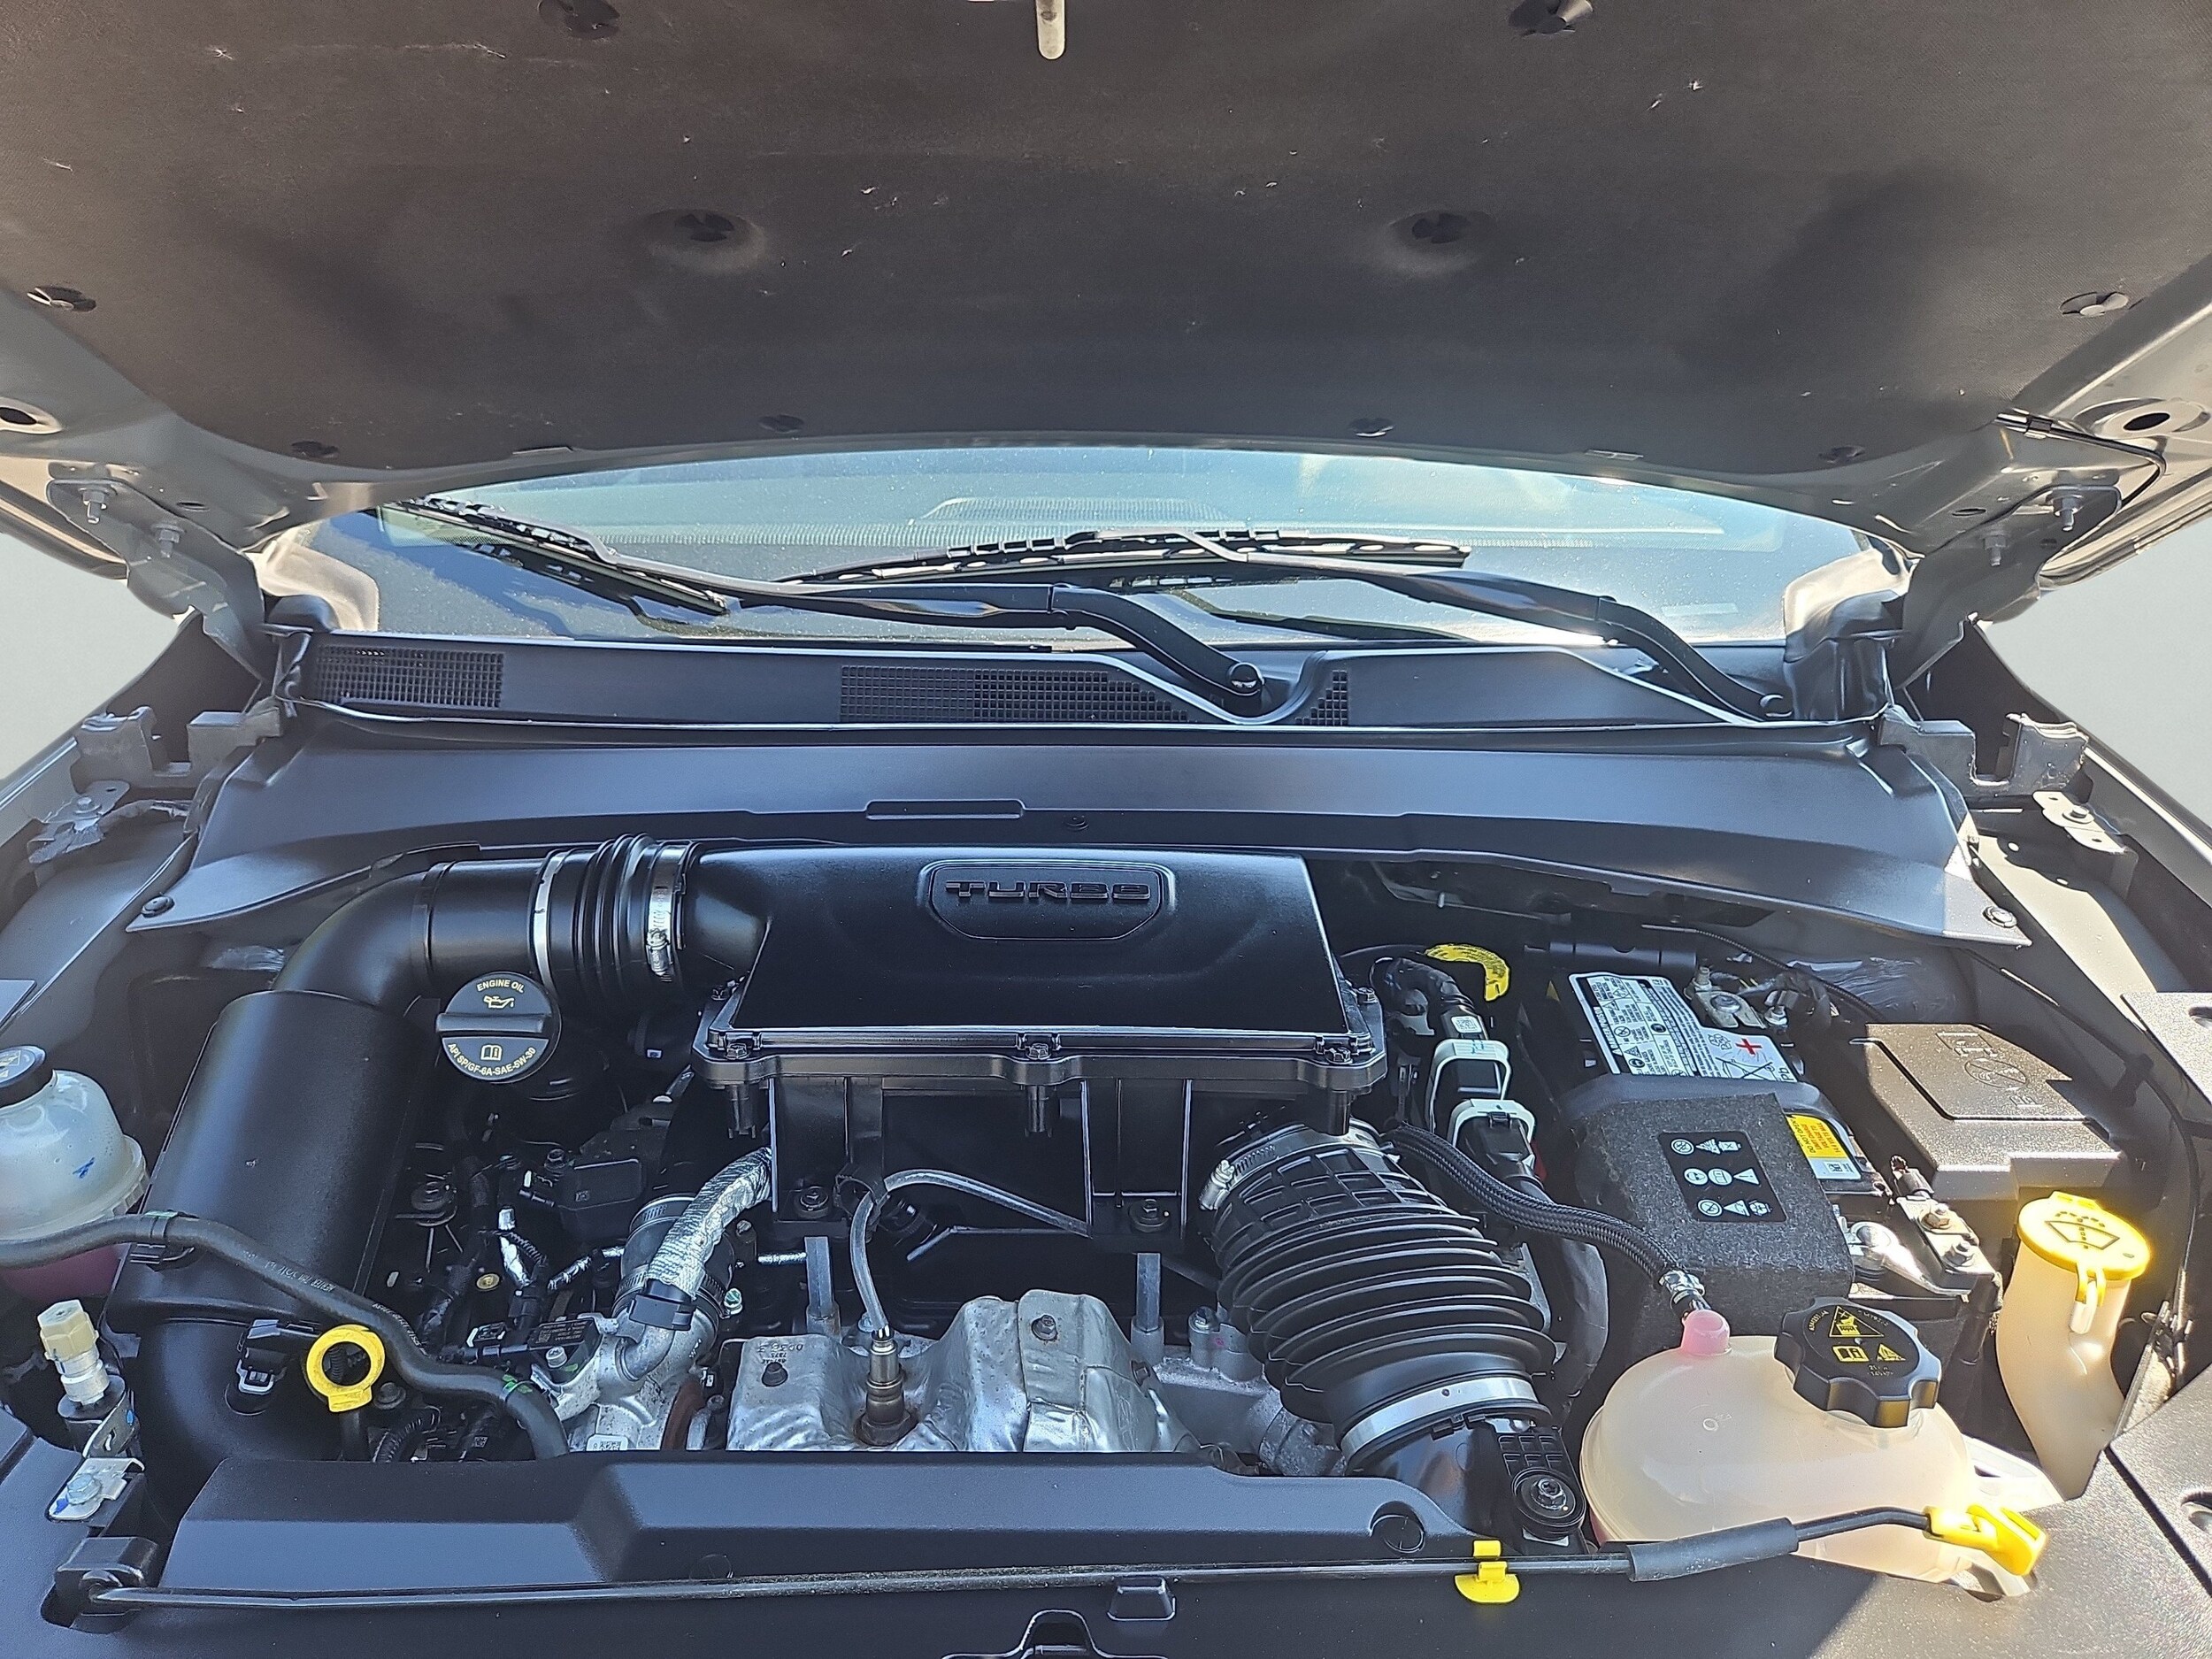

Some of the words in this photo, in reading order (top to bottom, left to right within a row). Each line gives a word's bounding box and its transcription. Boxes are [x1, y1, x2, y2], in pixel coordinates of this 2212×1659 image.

[945, 880, 1150, 900] TURBO
[476, 979, 511, 992] ENGINE
[511, 980, 525, 994] OIL
[448, 1043, 459, 1059] API
[1778, 1067, 1794, 1080] Pb
[1800, 1133, 1811, 1145] NOT
[1807, 1145, 1816, 1154] DO
